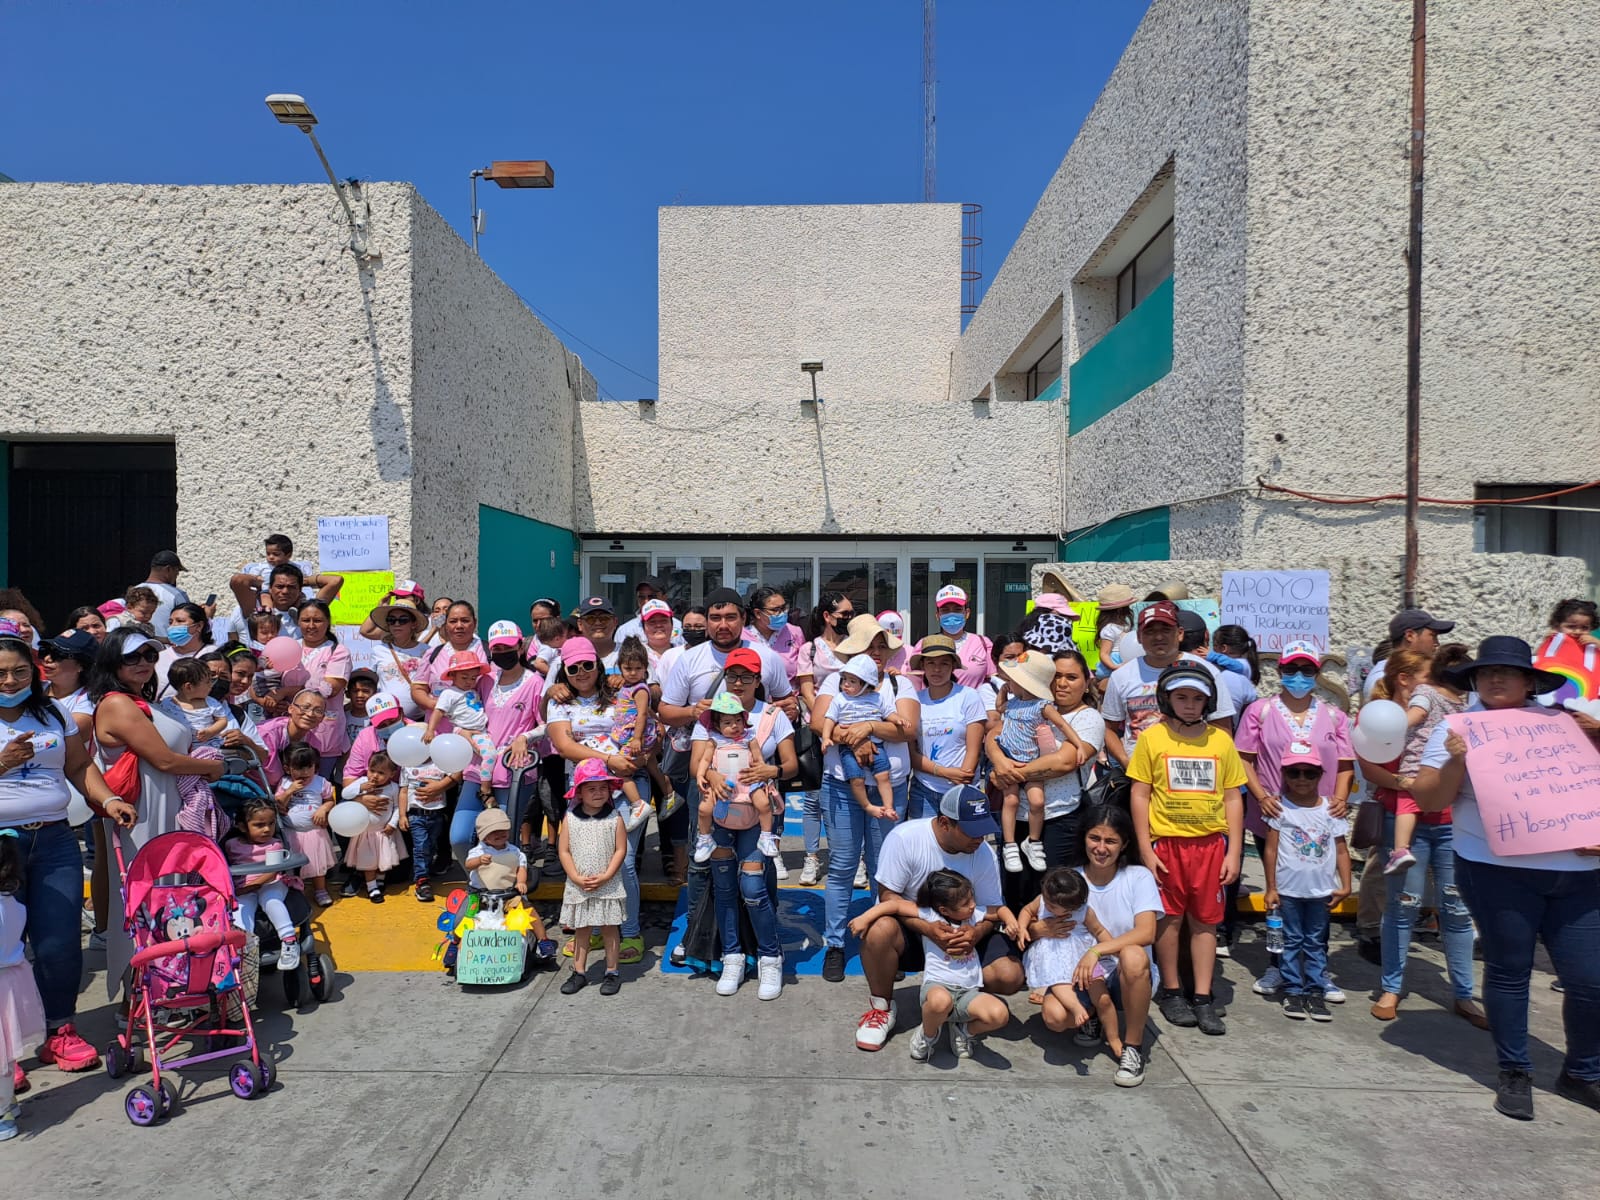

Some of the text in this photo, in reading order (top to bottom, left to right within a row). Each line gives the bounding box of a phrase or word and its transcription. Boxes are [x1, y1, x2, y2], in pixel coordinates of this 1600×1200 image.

[331, 547, 370, 559] servicio
[1225, 577, 1314, 600] APOYO
[1225, 603, 1234, 613] a
[1237, 602, 1256, 613] mis
[1495, 751, 1518, 764] se
[467, 950, 518, 965] PAPALOTE
[476, 976, 505, 984] HOGAR
